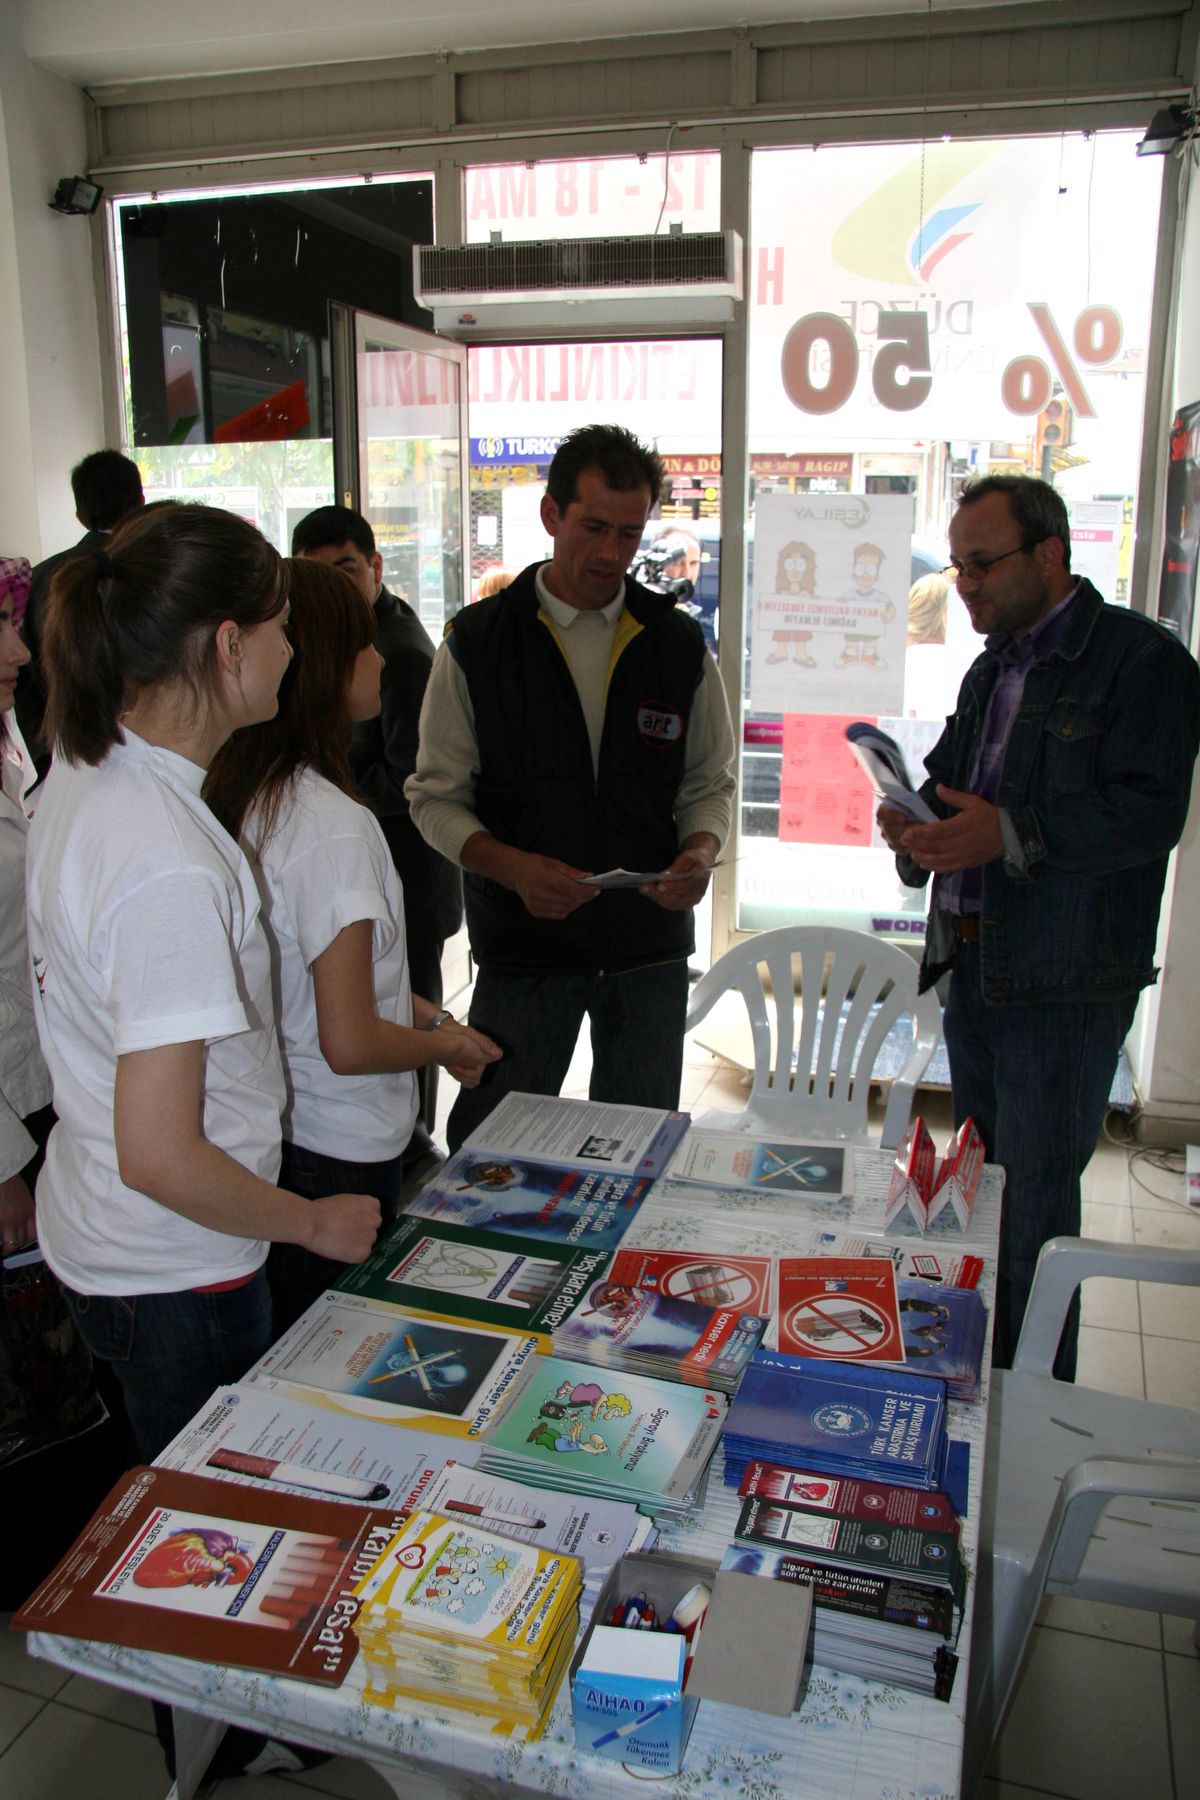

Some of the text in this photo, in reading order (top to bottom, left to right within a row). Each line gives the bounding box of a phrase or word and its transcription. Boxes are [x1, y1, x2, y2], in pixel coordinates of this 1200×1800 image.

[553, 1270, 592, 1295] para
[704, 1312, 733, 1342] kanser
[490, 1369, 520, 1407] kanser
[899, 1400, 912, 1414] VE
[911, 1402, 926, 1437] KURUMU
[647, 1406, 670, 1439] Sigarayı
[871, 1397, 898, 1457] TÜRK KANSER
[159, 1511, 171, 1521] 20
[143, 1522, 164, 1544] ADET
[780, 1569, 798, 1579] son
[782, 1562, 811, 1576] sigara
[812, 1567, 824, 1576] ve
[524, 1586, 545, 1617] kanser
[585, 1688, 646, 1714] AIHAO
[628, 1737, 670, 1750] Otomatik
[640, 1757, 670, 1768] Kalem
